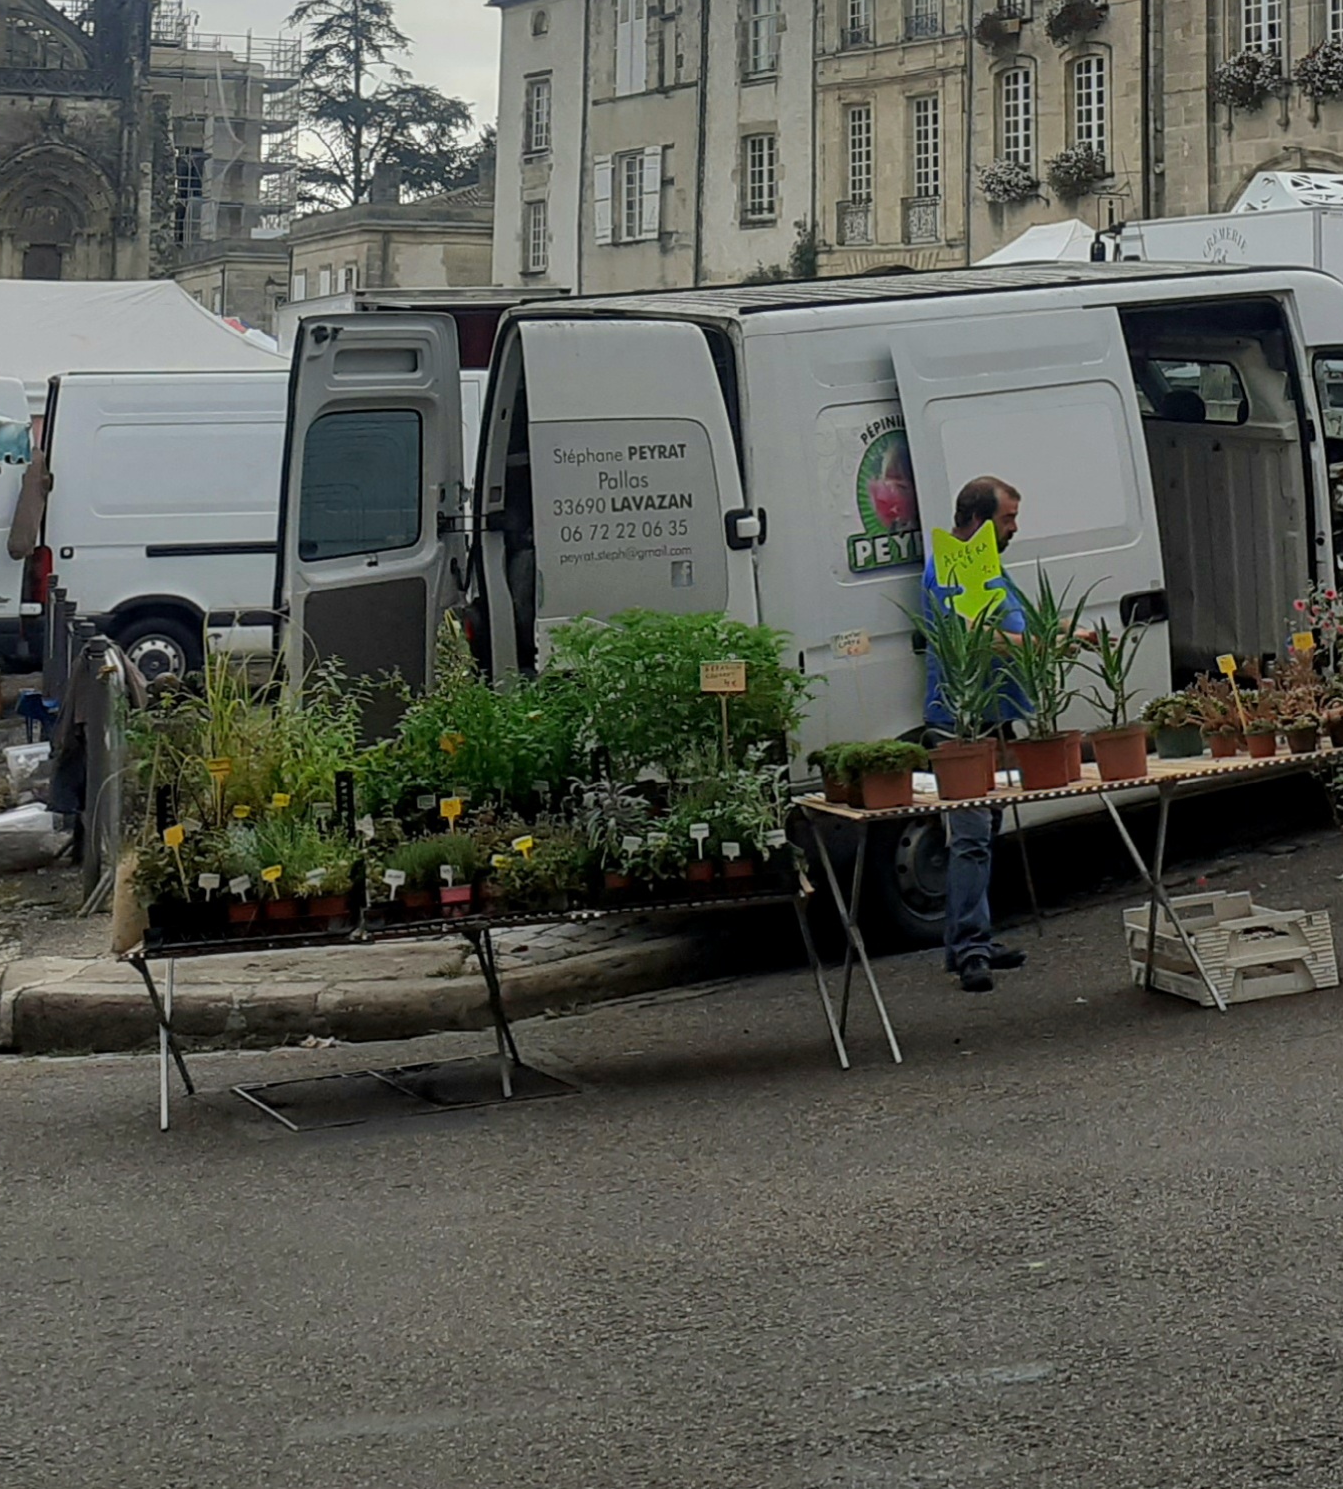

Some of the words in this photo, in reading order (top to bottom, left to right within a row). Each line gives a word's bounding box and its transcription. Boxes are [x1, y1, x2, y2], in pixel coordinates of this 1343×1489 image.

[553, 447, 623, 466] Stéphane
[628, 443, 687, 461] PEYRAT
[598, 470, 649, 490] Pallas
[553, 497, 606, 516] 33690
[610, 493, 693, 513] LAVAZAN
[560, 525, 583, 542] 06
[589, 524, 609, 541] 72
[615, 522, 636, 539] 22
[642, 520, 663, 538] 06
[668, 519, 688, 536] 35
[560, 545, 692, 566] peyrat.steph@gmail.com
